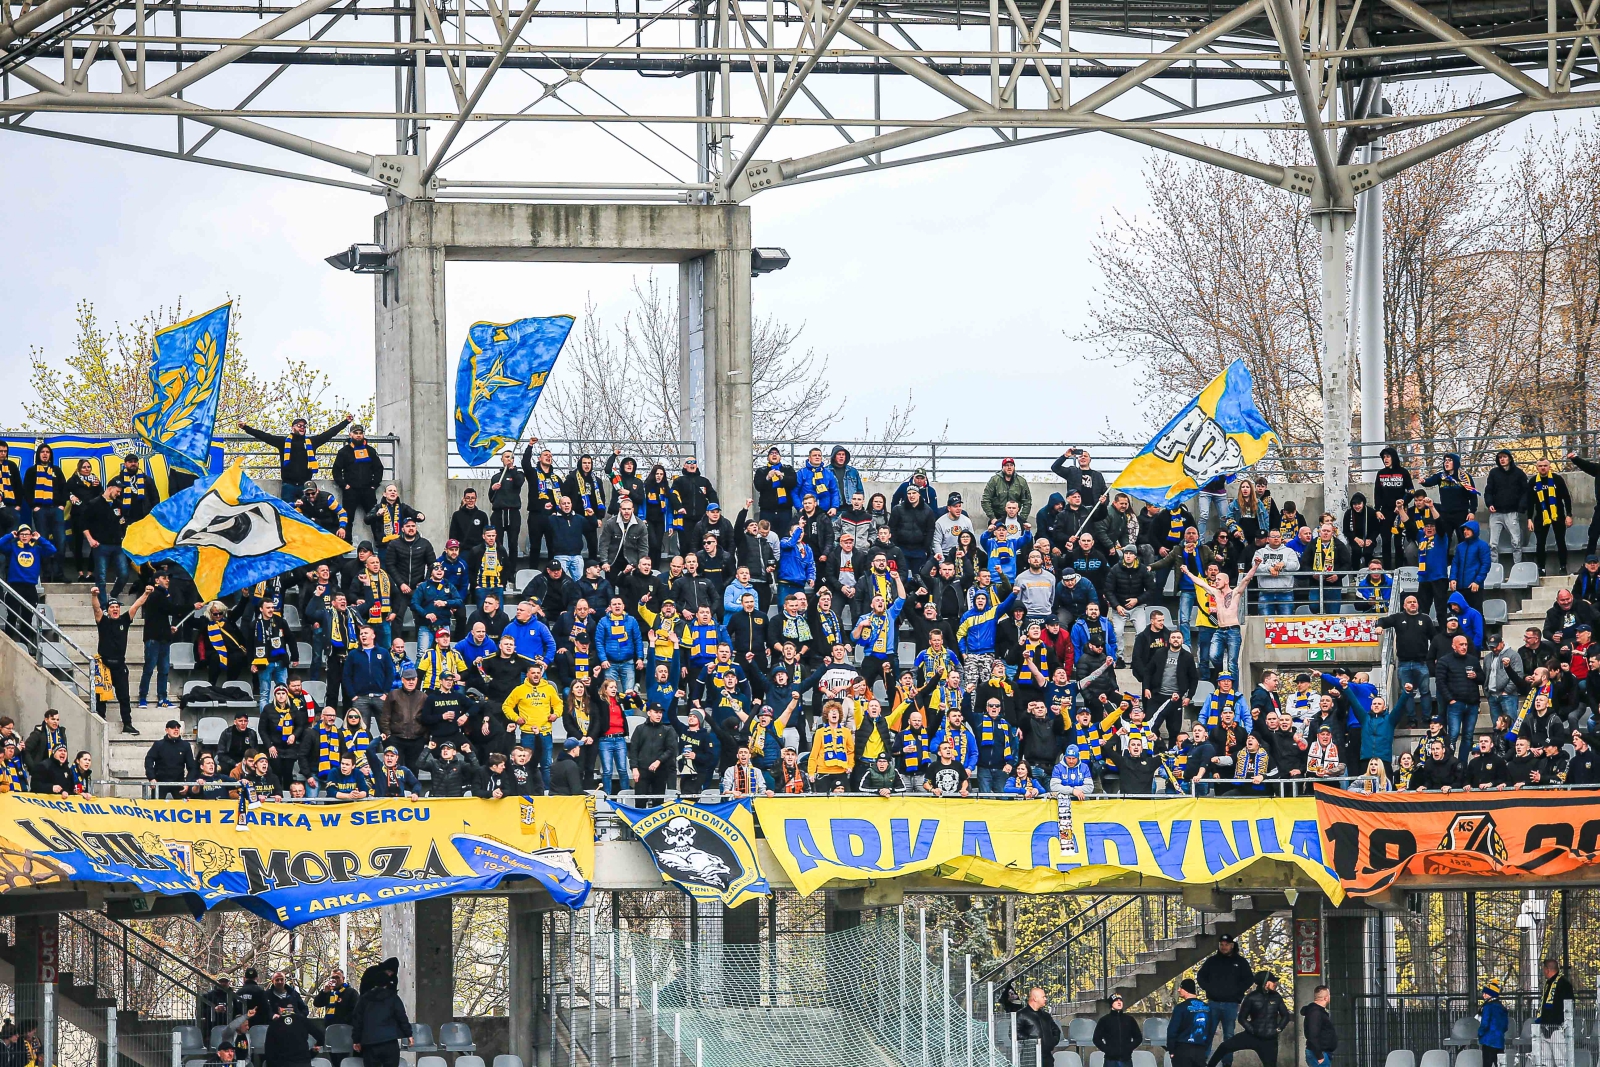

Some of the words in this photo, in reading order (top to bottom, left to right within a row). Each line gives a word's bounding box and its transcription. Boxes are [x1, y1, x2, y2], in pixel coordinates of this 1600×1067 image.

[12, 795, 77, 813] TYSIĄCE
[78, 803, 109, 815] MIL
[109, 804, 211, 823] MORSKICH
[219, 809, 235, 824] Z
[246, 811, 312, 831] ARKĄ
[321, 813, 341, 828] W
[351, 806, 431, 825] SERCU
[635, 808, 676, 835] RYGADA
[679, 806, 739, 842] WITOMINO
[1458, 820, 1475, 832] KS
[784, 818, 995, 874] ARKA
[238, 838, 455, 896] MORZA
[309, 892, 373, 914] ARKA
